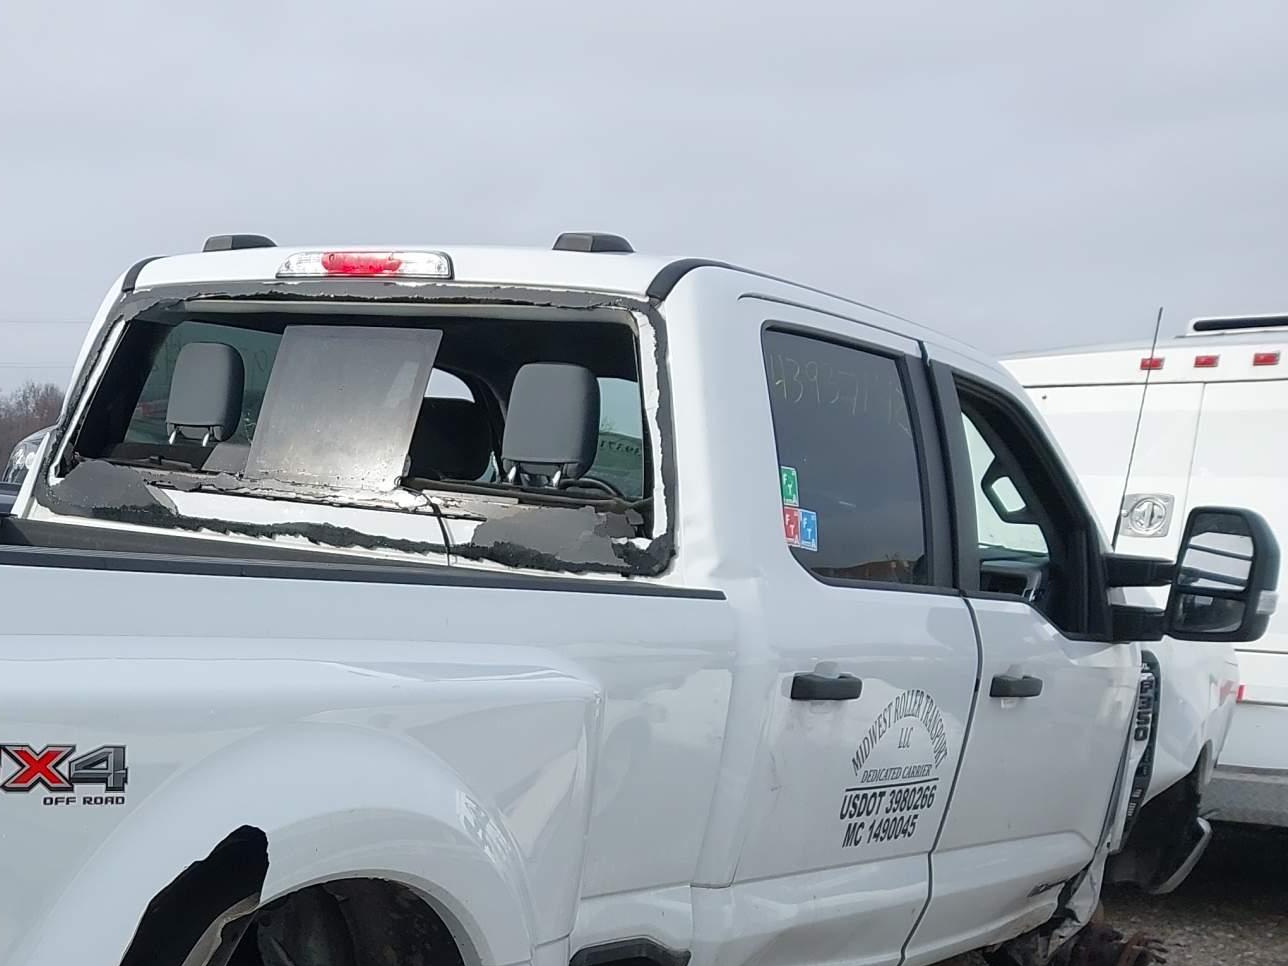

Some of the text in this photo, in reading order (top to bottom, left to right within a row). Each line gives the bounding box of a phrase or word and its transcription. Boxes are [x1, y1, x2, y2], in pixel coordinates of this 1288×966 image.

[851, 689, 948, 777] MIDWEST ROLLER TRANSPORT
[860, 763, 933, 784] DEDICATED CARRIER
[42, 795, 126, 806] OFF ROAD
[839, 785, 937, 820] USDOT 3980266
[841, 814, 919, 848] MC 1490045
